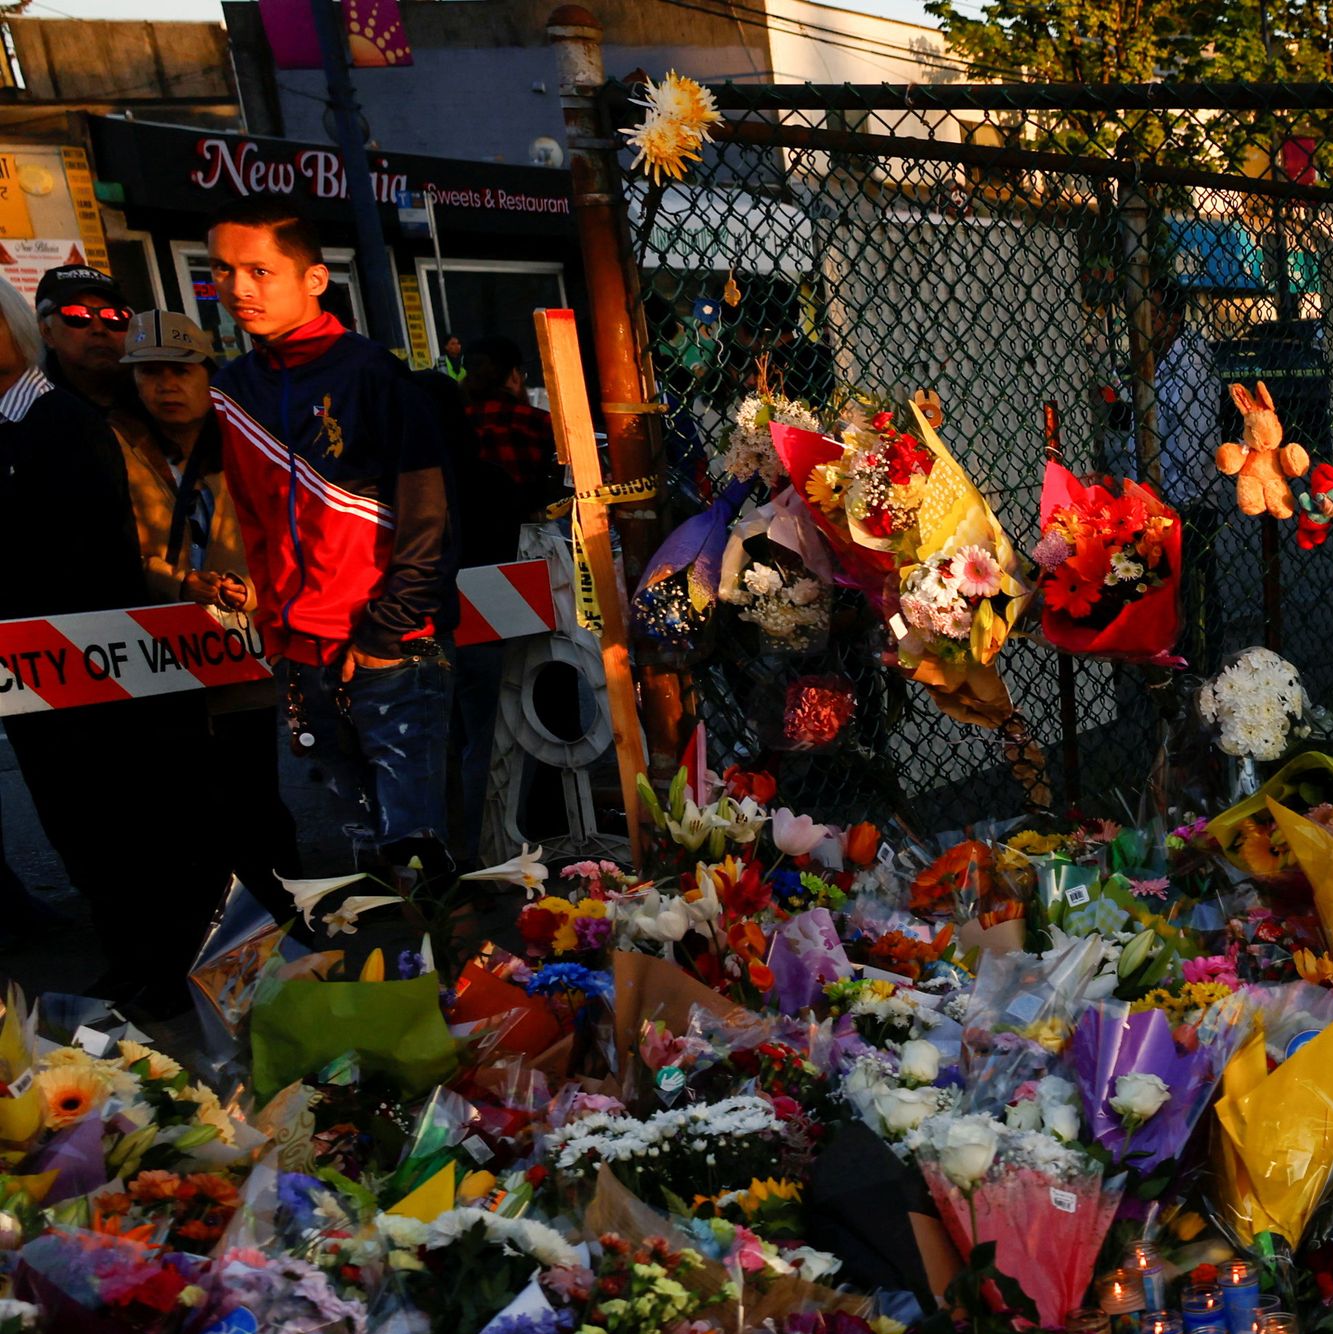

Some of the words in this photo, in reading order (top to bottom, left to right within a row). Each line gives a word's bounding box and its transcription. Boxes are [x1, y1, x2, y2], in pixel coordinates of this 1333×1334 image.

[188, 138, 297, 197] New
[296, 149, 408, 203] Bia
[427, 183, 481, 208] Sweets
[484, 188, 496, 209] &
[499, 189, 571, 215] Restaurant
[0, 647, 68, 693] CITY
[84, 641, 129, 681] OF
